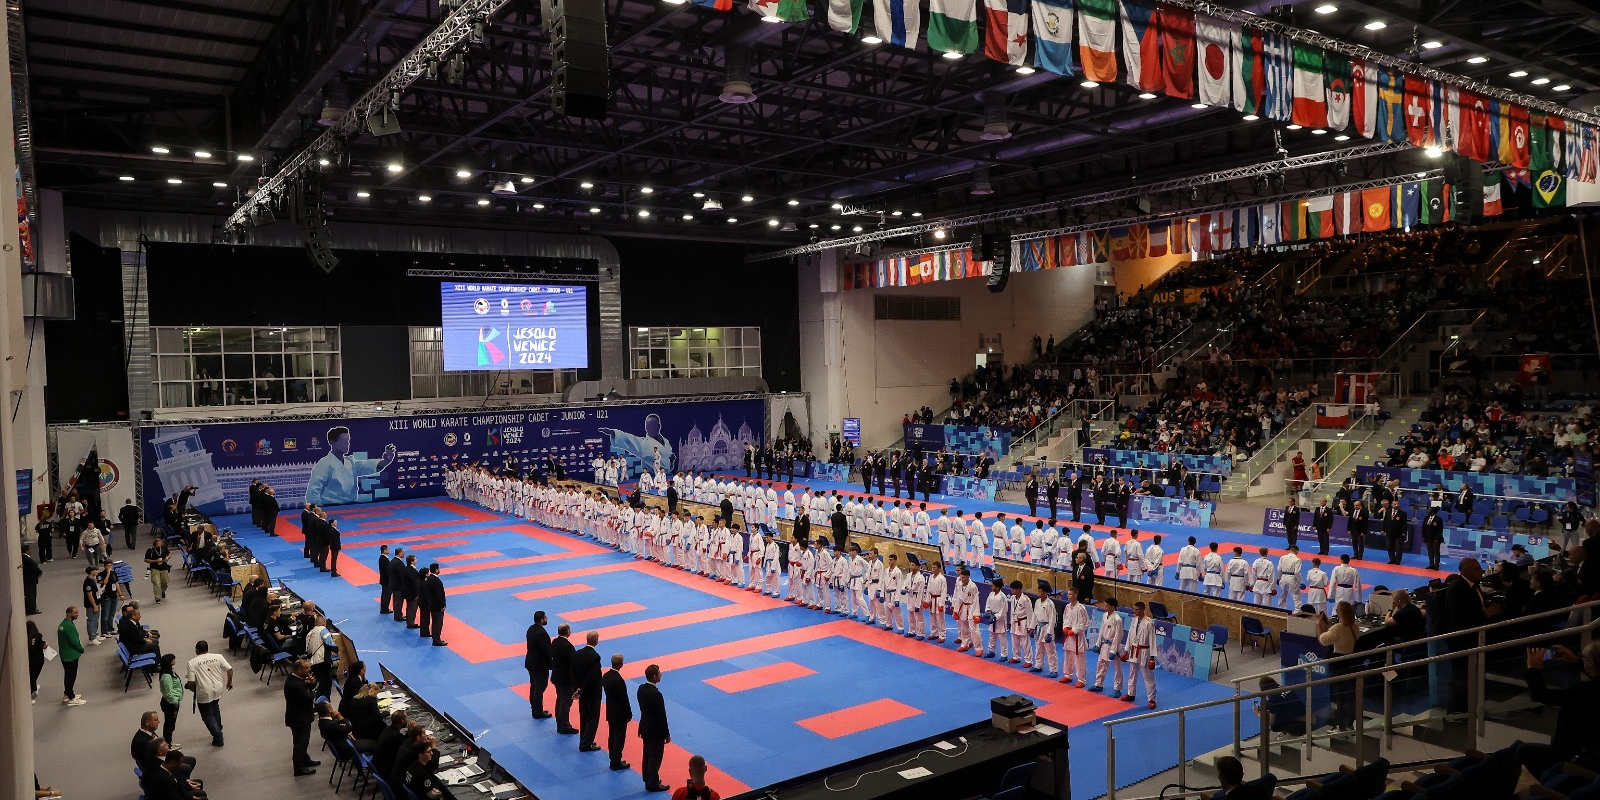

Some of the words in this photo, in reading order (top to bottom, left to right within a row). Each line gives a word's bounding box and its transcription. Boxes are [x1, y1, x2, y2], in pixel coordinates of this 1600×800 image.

[1152, 292, 1176, 303] AUS
[513, 328, 556, 339] JESOLO
[513, 340, 556, 351] VENICE
[519, 352, 552, 364] 2024
[389, 420, 408, 430] XIII
[412, 418, 436, 429] WORLD
[441, 417, 468, 427] KARATE
[472, 414, 524, 426] CHAMPIONSHIP
[528, 413, 549, 422] CADET
[561, 411, 586, 420] JUNIOR
[596, 410, 608, 419] U21
[1269, 522, 1286, 530] JESOL
